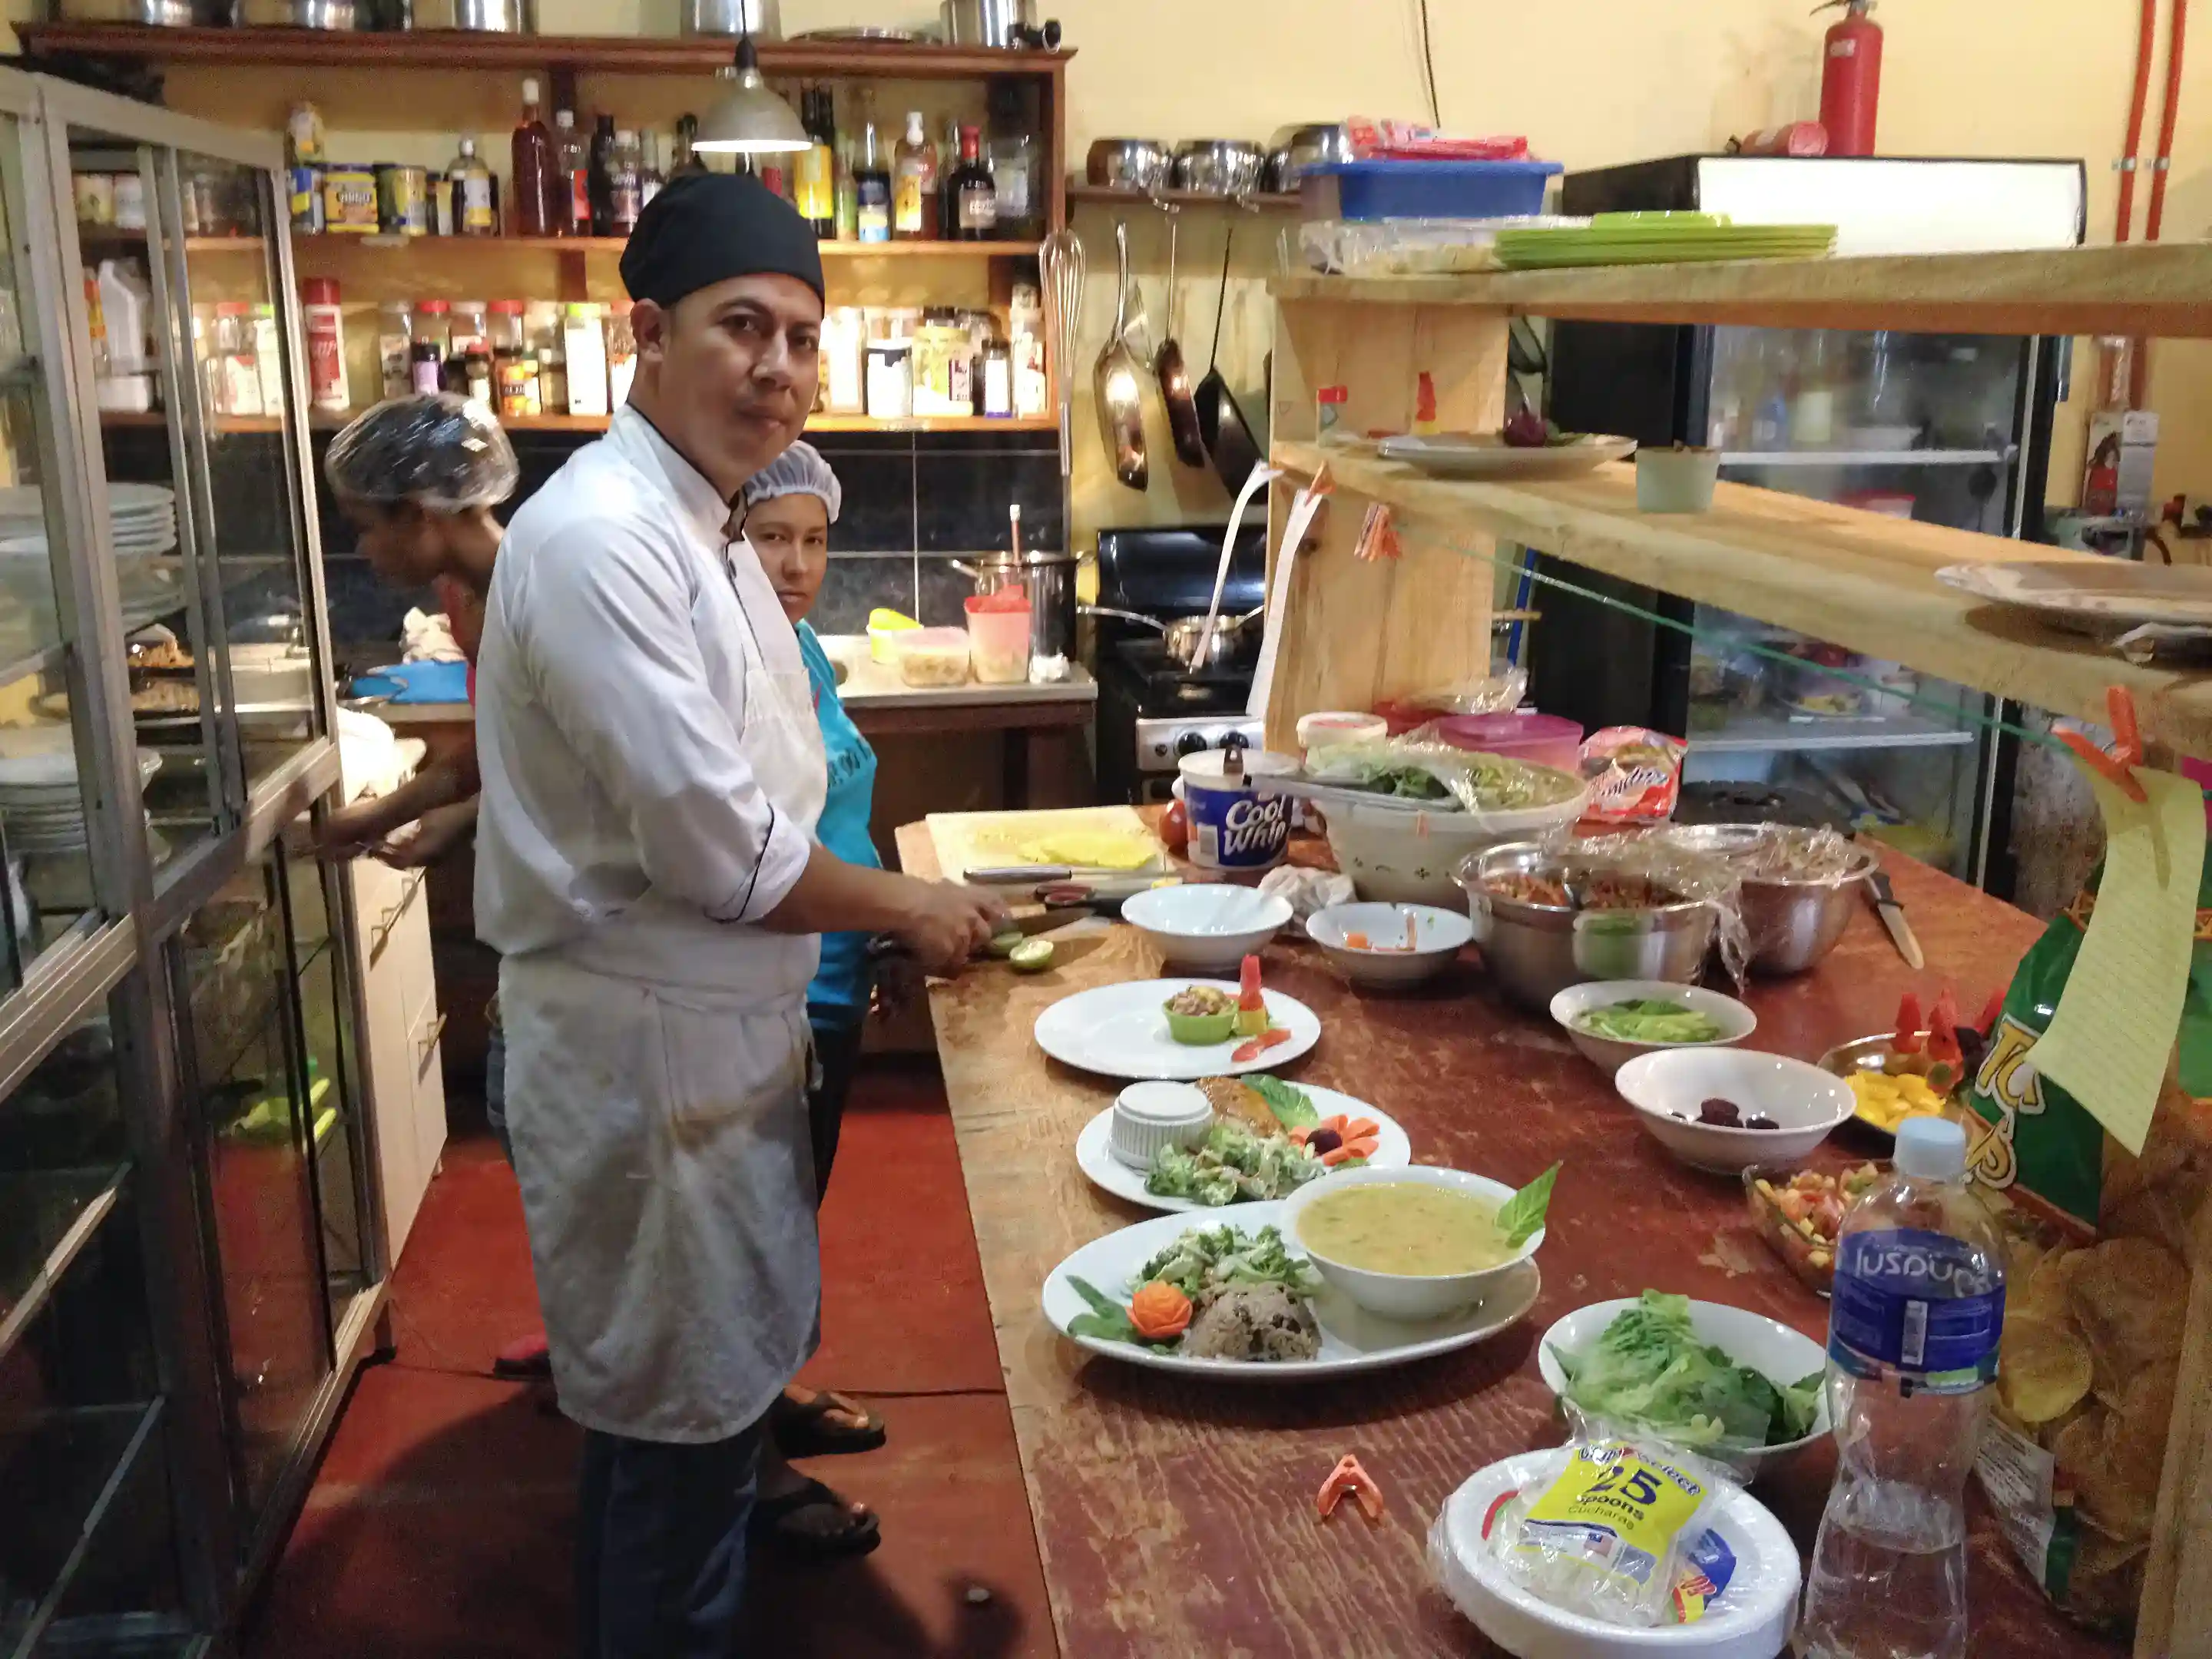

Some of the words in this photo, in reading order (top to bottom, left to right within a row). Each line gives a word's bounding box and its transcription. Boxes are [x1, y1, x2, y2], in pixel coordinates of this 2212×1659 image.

[1226, 794, 1286, 830] Cool
[1224, 818, 1286, 856] Whip
[1585, 1465, 1664, 1505] 25
